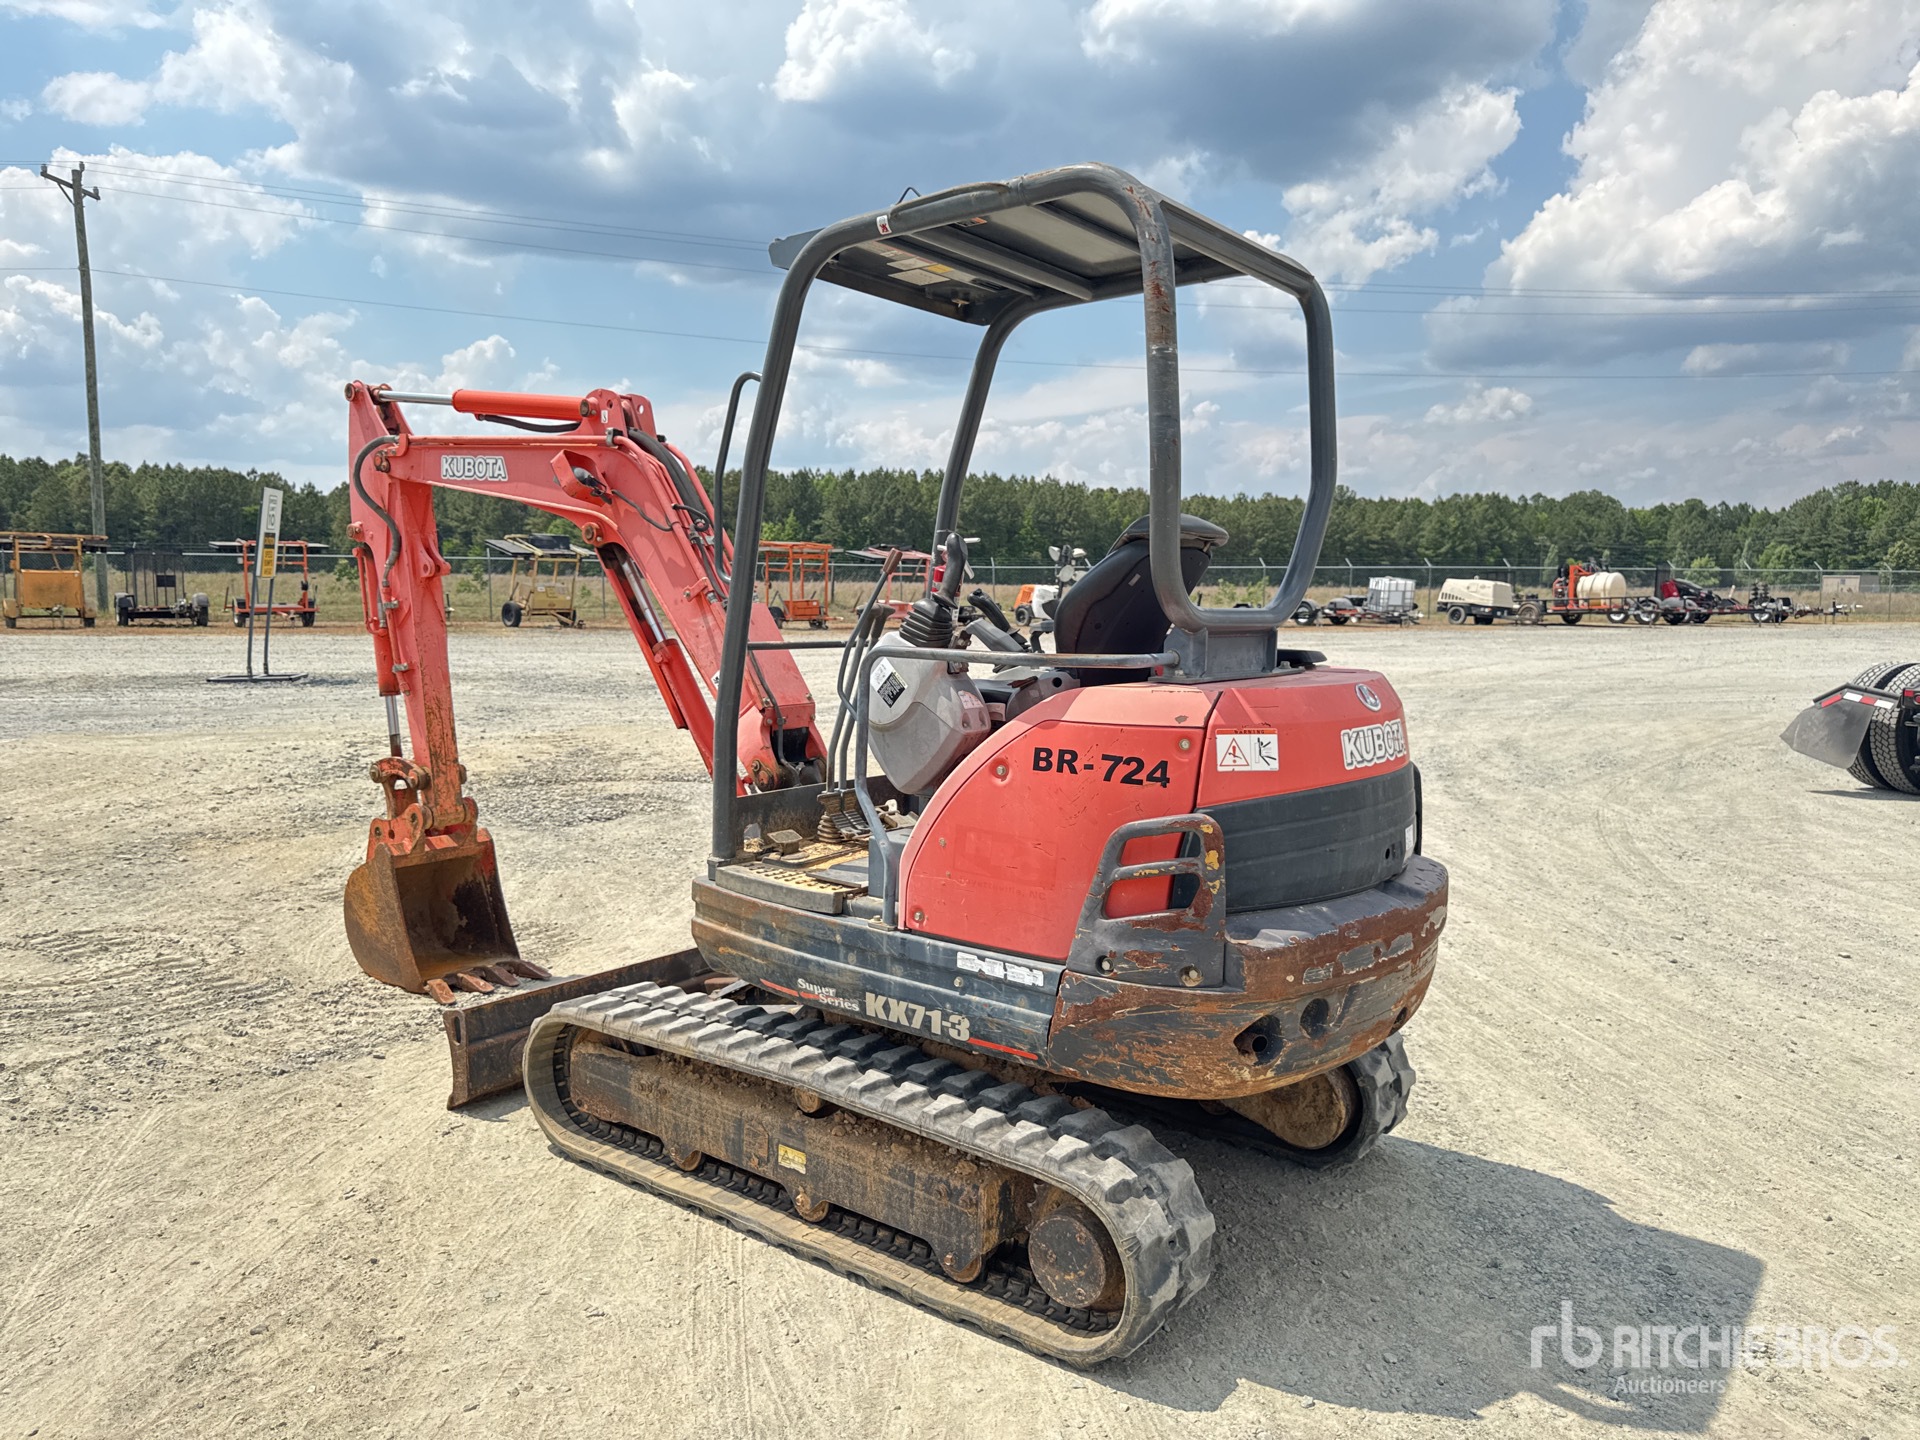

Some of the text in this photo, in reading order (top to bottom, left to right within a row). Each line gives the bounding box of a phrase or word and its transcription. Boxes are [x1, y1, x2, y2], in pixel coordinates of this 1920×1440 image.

[441, 455, 508, 481] KUBOTA
[1341, 719, 1407, 770] KUBOTA
[1032, 747, 1171, 788] BR-724
[797, 978, 836, 997] Super
[819, 994, 860, 1012] Series
[865, 993, 970, 1042] KX71-3
